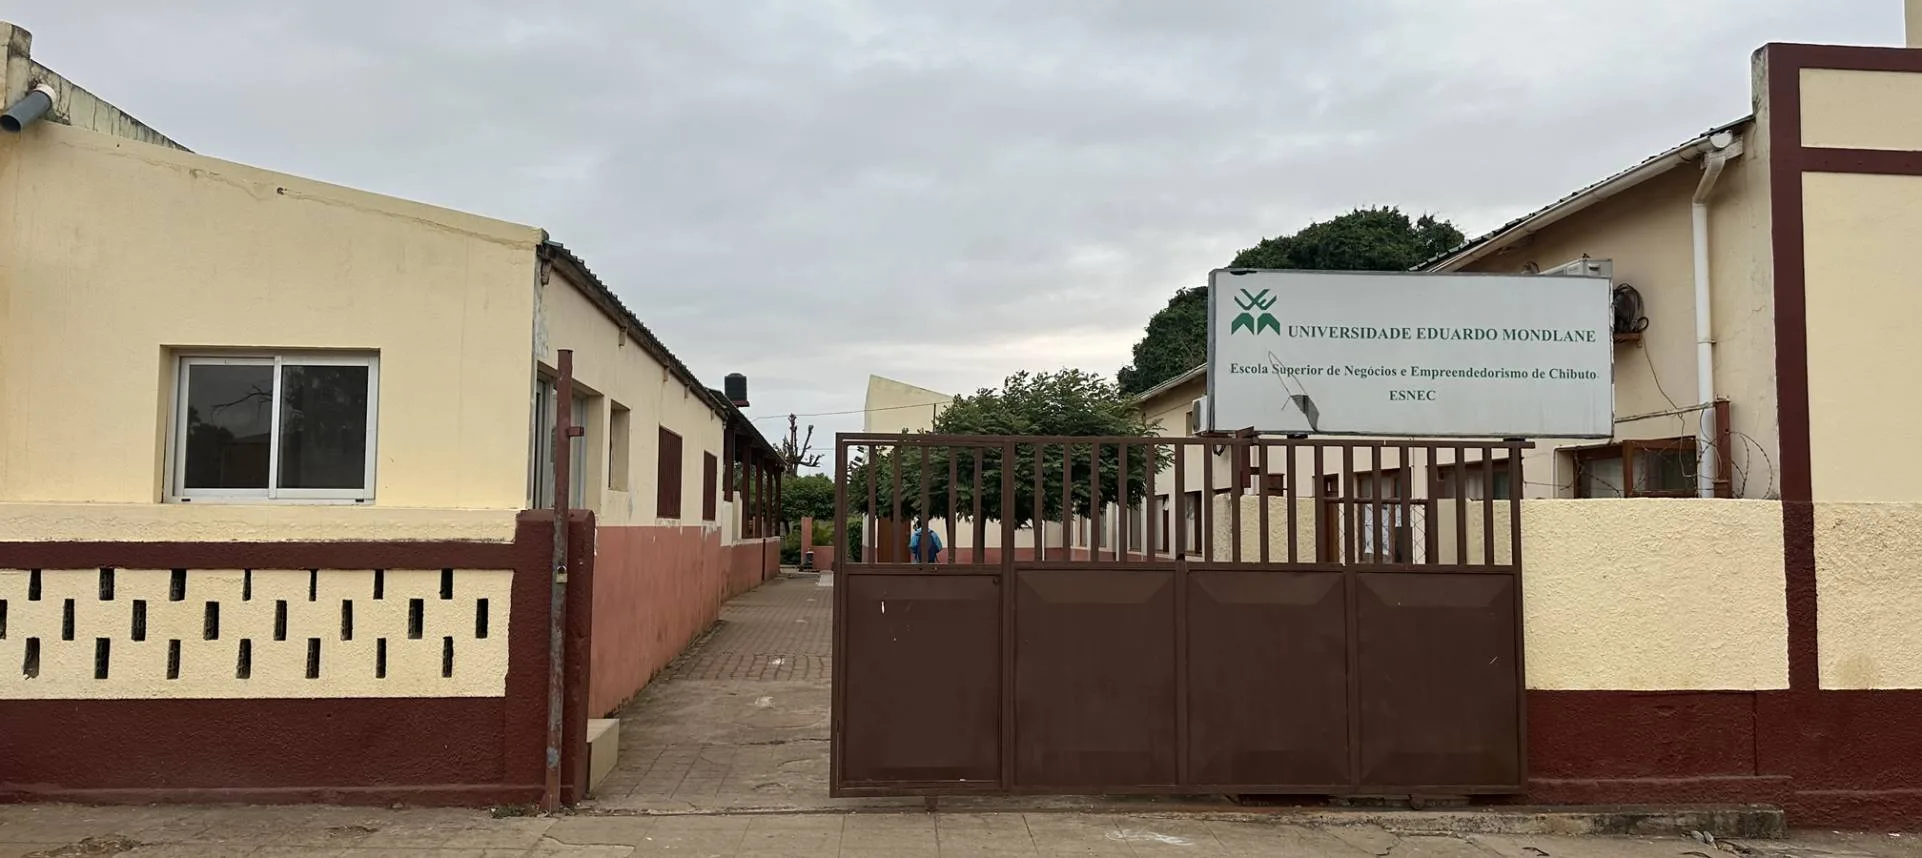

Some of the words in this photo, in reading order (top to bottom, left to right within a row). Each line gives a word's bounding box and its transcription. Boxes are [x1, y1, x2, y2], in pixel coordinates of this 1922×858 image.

[1288, 325, 1412, 340] UNIVERSIDADE
[1416, 327, 1499, 341] EDUARDO
[1502, 328, 1597, 343] MONDLANE
[1230, 362, 1269, 375] Escola
[1272, 363, 1324, 377] Superior
[1326, 364, 1341, 376] de
[1344, 365, 1398, 379] Negócios
[1400, 368, 1408, 377] e
[1410, 365, 1529, 381] Empreendedorismo
[1531, 367, 1546, 379] de
[1388, 389, 1437, 401] ESNEC
